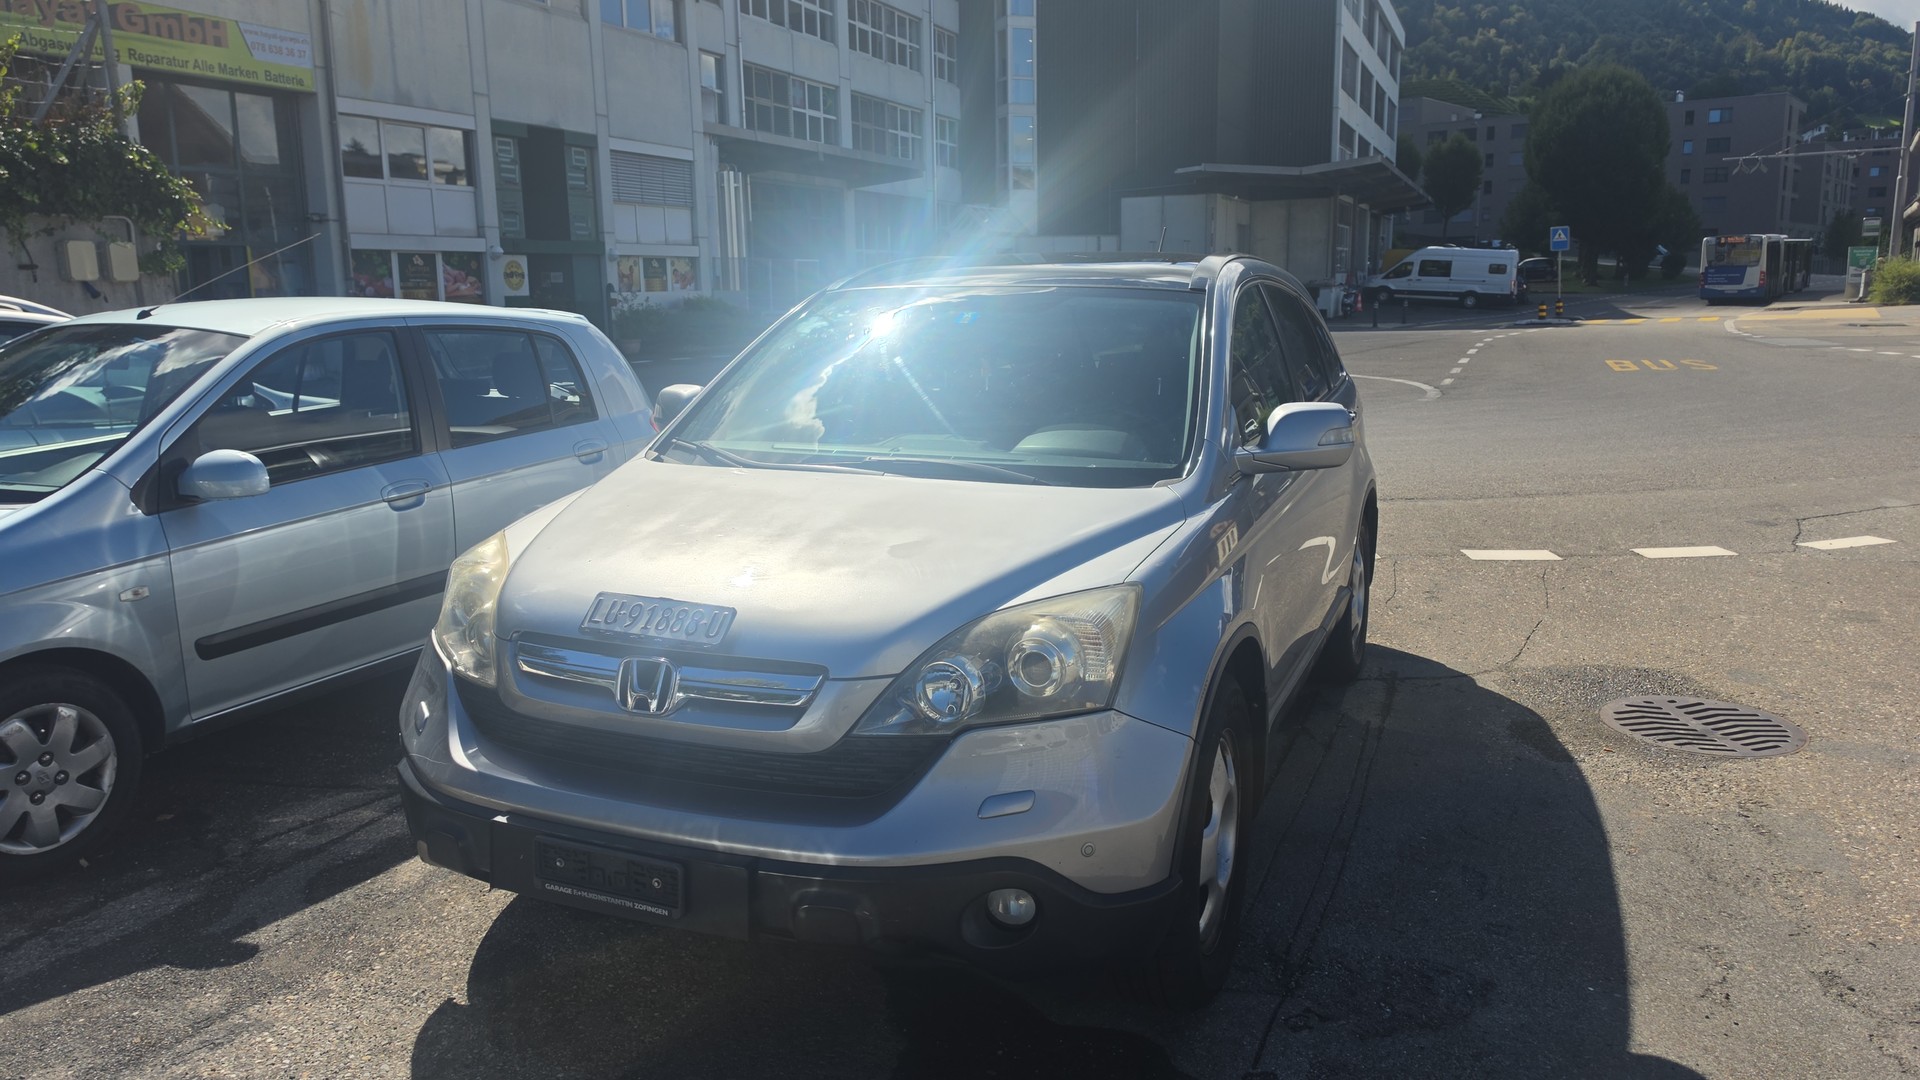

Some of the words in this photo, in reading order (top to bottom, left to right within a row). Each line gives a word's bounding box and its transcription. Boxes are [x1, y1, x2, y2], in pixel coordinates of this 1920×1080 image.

[115, 1, 229, 48] GmbH
[127, 48, 189, 67] Reparatur
[192, 58, 215, 73] Alle
[218, 63, 258, 80] Marken
[264, 70, 304, 87] Batterie
[1604, 359, 1718, 371] BUS
[545, 883, 573, 895] GARAGE
[633, 902, 669, 916] ZOFINGEN
